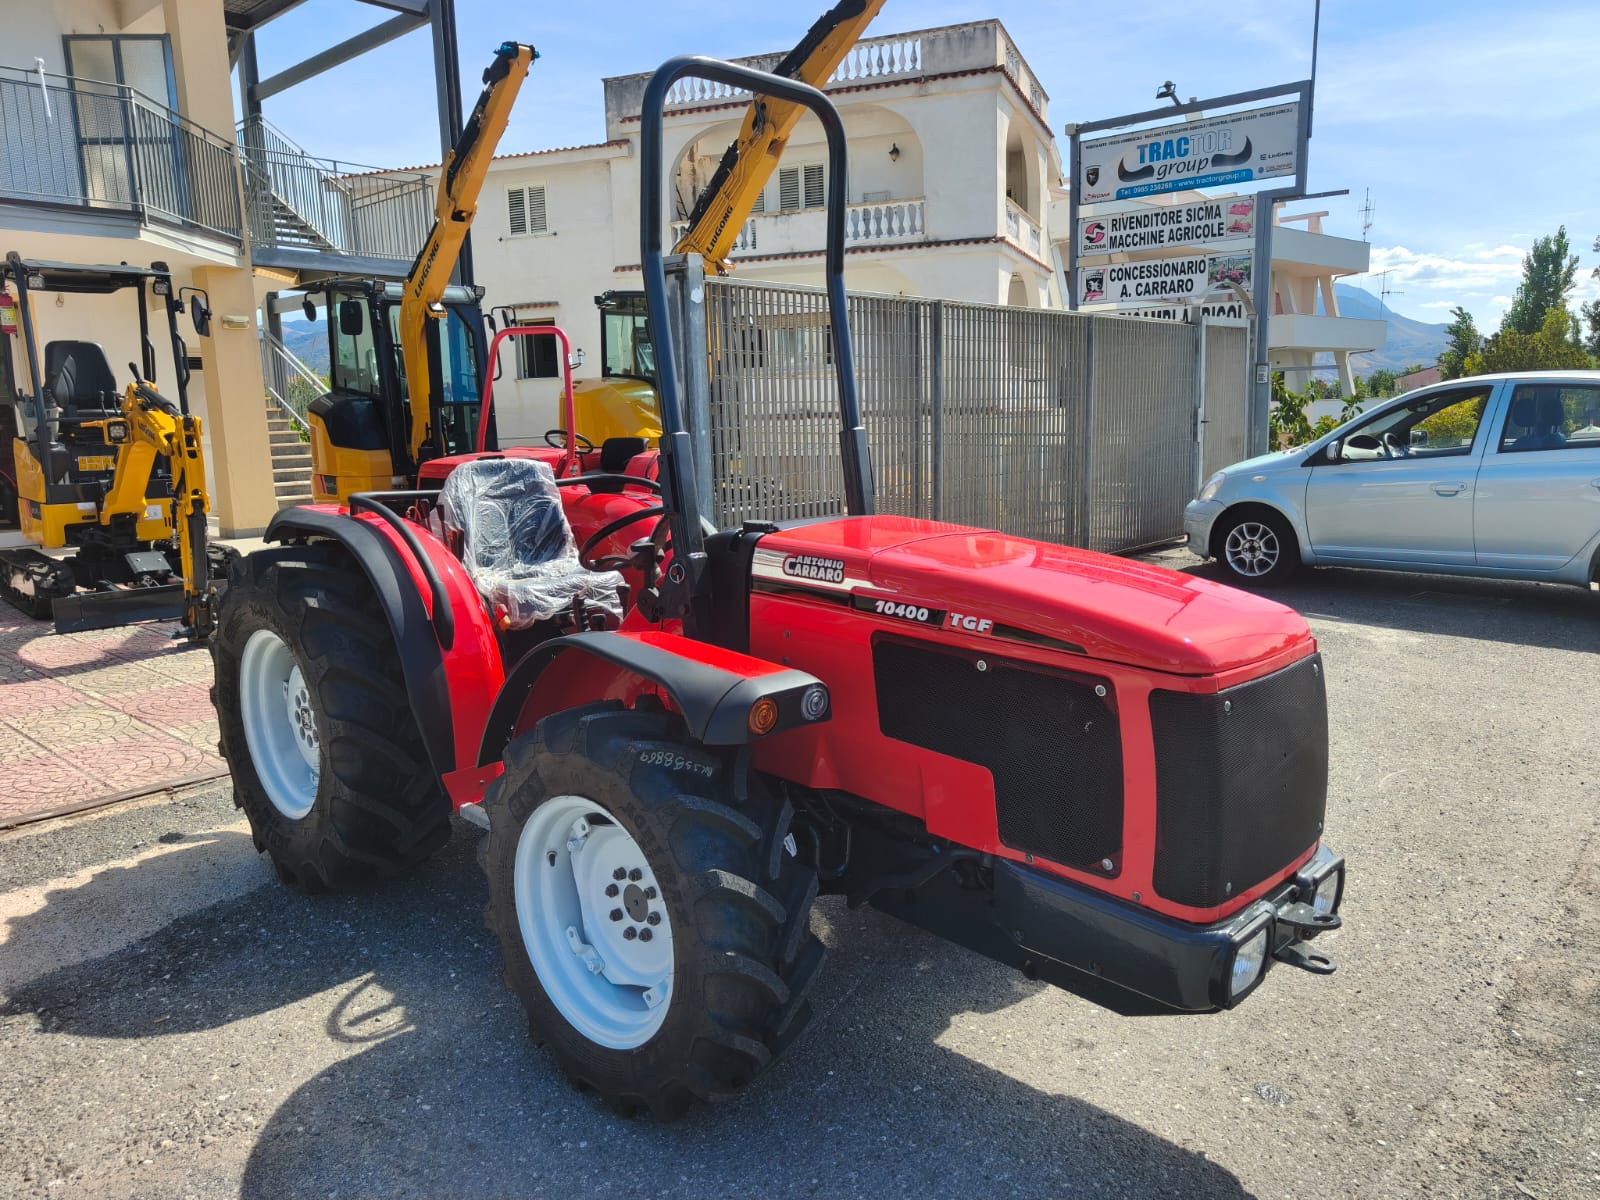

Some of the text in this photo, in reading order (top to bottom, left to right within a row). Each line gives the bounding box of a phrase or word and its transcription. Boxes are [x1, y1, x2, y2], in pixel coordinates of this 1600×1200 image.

[1137, 128, 1233, 164] TRACTOR
[1156, 153, 1209, 180] group
[1111, 204, 1222, 232] RIVENDITORE SICMA
[1109, 222, 1225, 249] MACCHINE AGRICOLE
[1109, 259, 1207, 282] CONCESSIONARIO
[1120, 278, 1194, 298] A. CARRARO
[784, 557, 843, 582] CARRARO
[796, 555, 844, 570] ANTONIO
[875, 600, 993, 632] 10400 TGF
